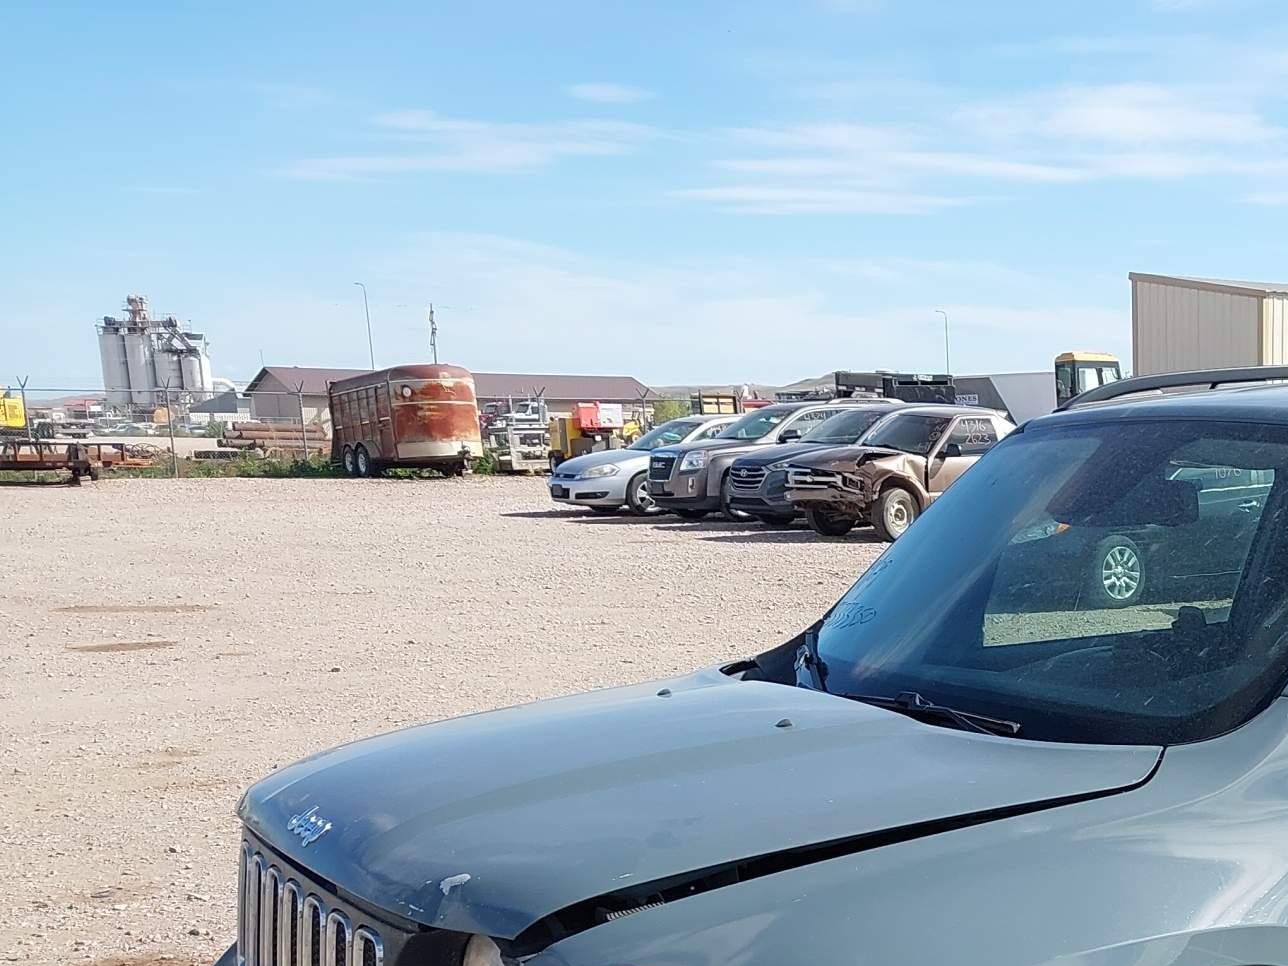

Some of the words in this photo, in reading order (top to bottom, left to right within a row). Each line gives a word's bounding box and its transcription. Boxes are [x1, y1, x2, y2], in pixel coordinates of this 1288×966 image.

[960, 419, 986, 433] 4316
[966, 432, 992, 446] 2623
[287, 805, 334, 848] Jeep
